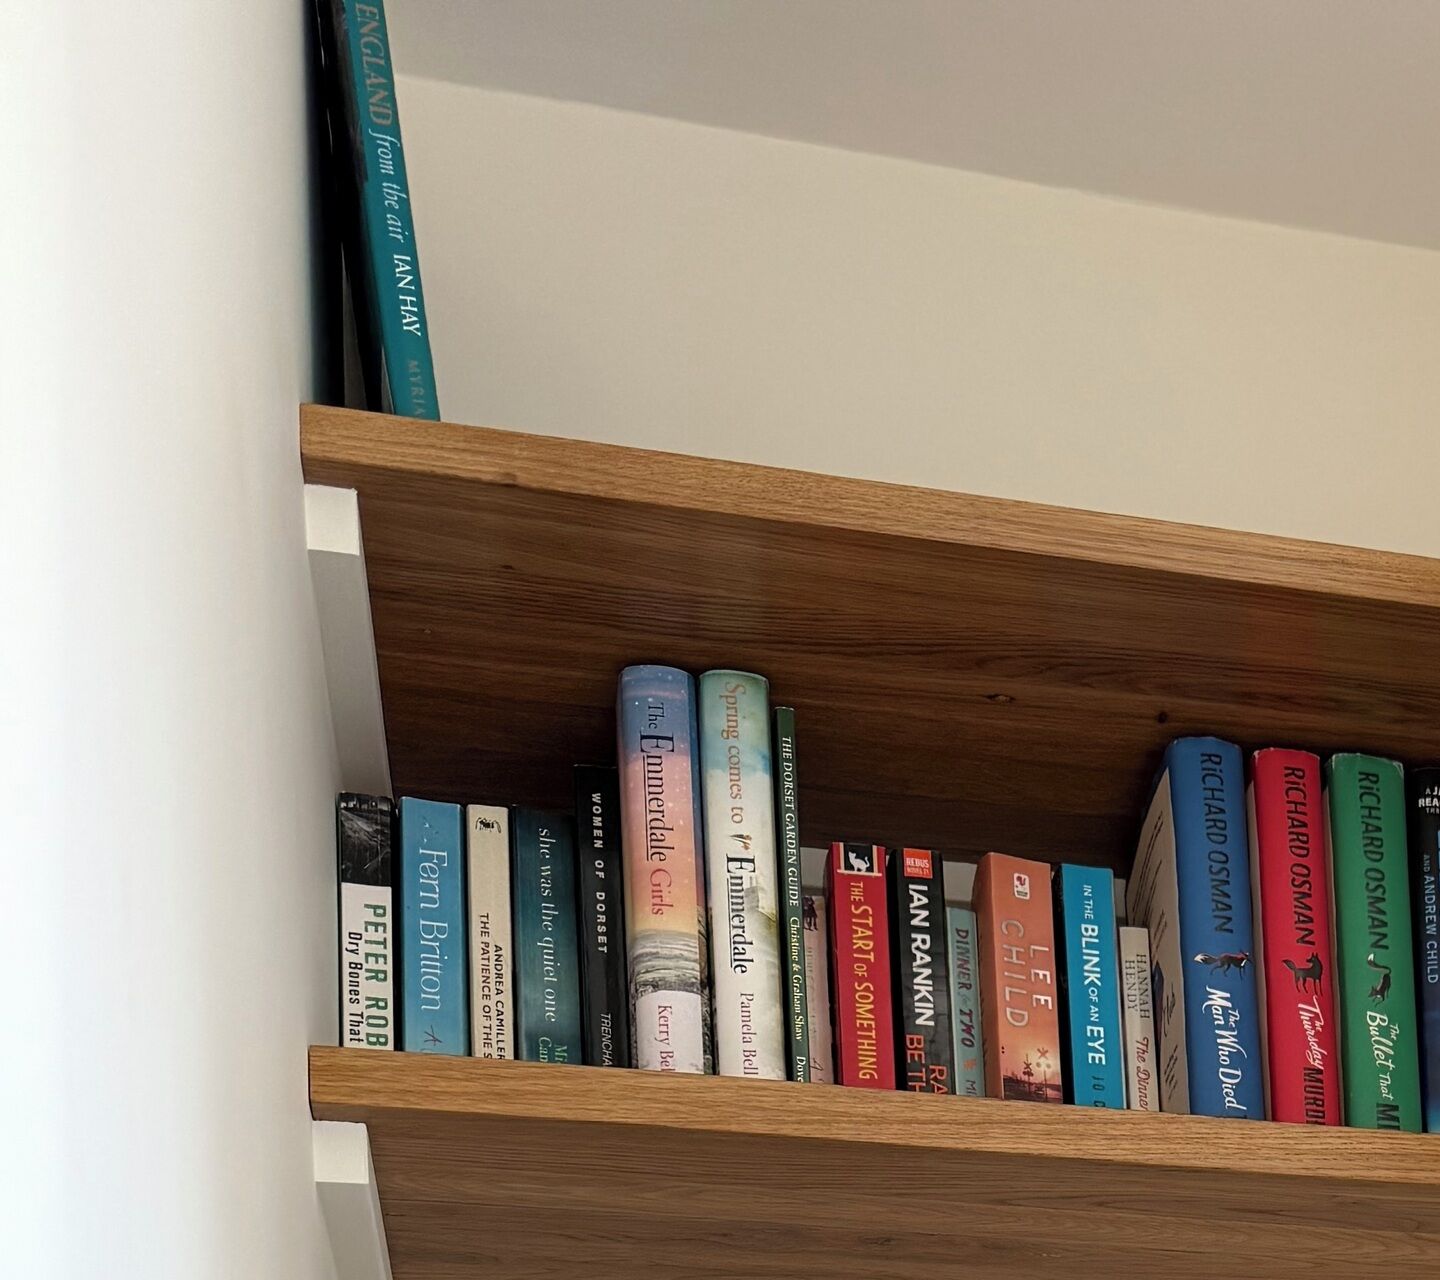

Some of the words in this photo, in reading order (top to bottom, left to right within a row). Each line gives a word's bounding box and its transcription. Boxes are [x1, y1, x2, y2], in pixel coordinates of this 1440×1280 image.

[355, 3, 393, 126] ENGLAND
[368, 128, 400, 175] from
[382, 182, 407, 209] the
[386, 213, 409, 243] air
[393, 254, 415, 289] IAN
[399, 295, 421, 336] HAY
[648, 702, 665, 729] The
[720, 681, 747, 740] Spring
[782, 736, 792, 759] THE
[728, 746, 743, 800] comes
[783, 763, 794, 809] DORSET
[1425, 787, 1432, 795] A
[639, 732, 675, 862] Emmerdale
[730, 807, 744, 824] to
[591, 793, 603, 848] WOMEN
[785, 813, 797, 865] GARDEN
[539, 828, 556, 859] she
[419, 848, 448, 909] Fern
[540, 865, 551, 897] was
[594, 860, 604, 879] OF
[788, 867, 799, 907] GUIDE
[1083, 884, 1093, 897] IN
[650, 868, 674, 916] Girls
[850, 881, 864, 902] THE
[908, 884, 929, 927] IAN
[1084, 899, 1094, 920] THE
[1207, 849, 1235, 935] OSMAN
[1289, 862, 1316, 947] OSMAN
[1362, 865, 1390, 950] OSMAN
[1424, 874, 1437, 935] ANDREW
[480, 913, 490, 938] THE
[541, 903, 558, 932] the
[596, 892, 607, 953] DORSET
[726, 853, 756, 974] Emmerdale
[851, 904, 874, 963] START
[345, 932, 362, 955] Dry
[364, 904, 387, 983] PETER
[537, 936, 560, 982] quiet
[790, 916, 800, 962] Christine
[955, 927, 972, 991] DINNER
[1081, 923, 1101, 986] BLINK
[348, 961, 363, 1004] Bones
[419, 921, 449, 1011] Britton
[481, 943, 491, 1000] PATIENCE
[494, 944, 504, 996] ANDREA
[792, 963, 802, 972] &
[911, 932, 935, 1026] RANKIN
[1001, 919, 1028, 1027] CHILD
[1029, 944, 1053, 1011] LEE
[1426, 941, 1439, 984] CHILD
[544, 988, 556, 1022] one
[792, 974, 803, 1013] Graham
[1088, 987, 1099, 1002] OF
[1125, 960, 1138, 1012] HENDY
[1136, 954, 1150, 1019] HANNAH
[1202, 985, 1232, 1025] Man
[349, 1012, 364, 1043] That
[365, 997, 389, 1047] ROB
[482, 1004, 491, 1022] OF
[654, 1004, 672, 1046] Kerry
[740, 993, 757, 1044] Pamela
[794, 1015, 806, 1041] Shaw
[855, 982, 878, 1080] SOMETHING
[959, 1008, 976, 1048] TWO
[1089, 1005, 1099, 1022] AN
[1298, 995, 1327, 1070] Thursday
[483, 1024, 493, 1049] THE
[1086, 1025, 1106, 1065] EYE
[1135, 1036, 1149, 1063] The
[1215, 1029, 1247, 1065] Who
[1366, 1010, 1395, 1070] Bullet
[1219, 1067, 1247, 1110] Died
[1379, 1072, 1393, 1100] That
